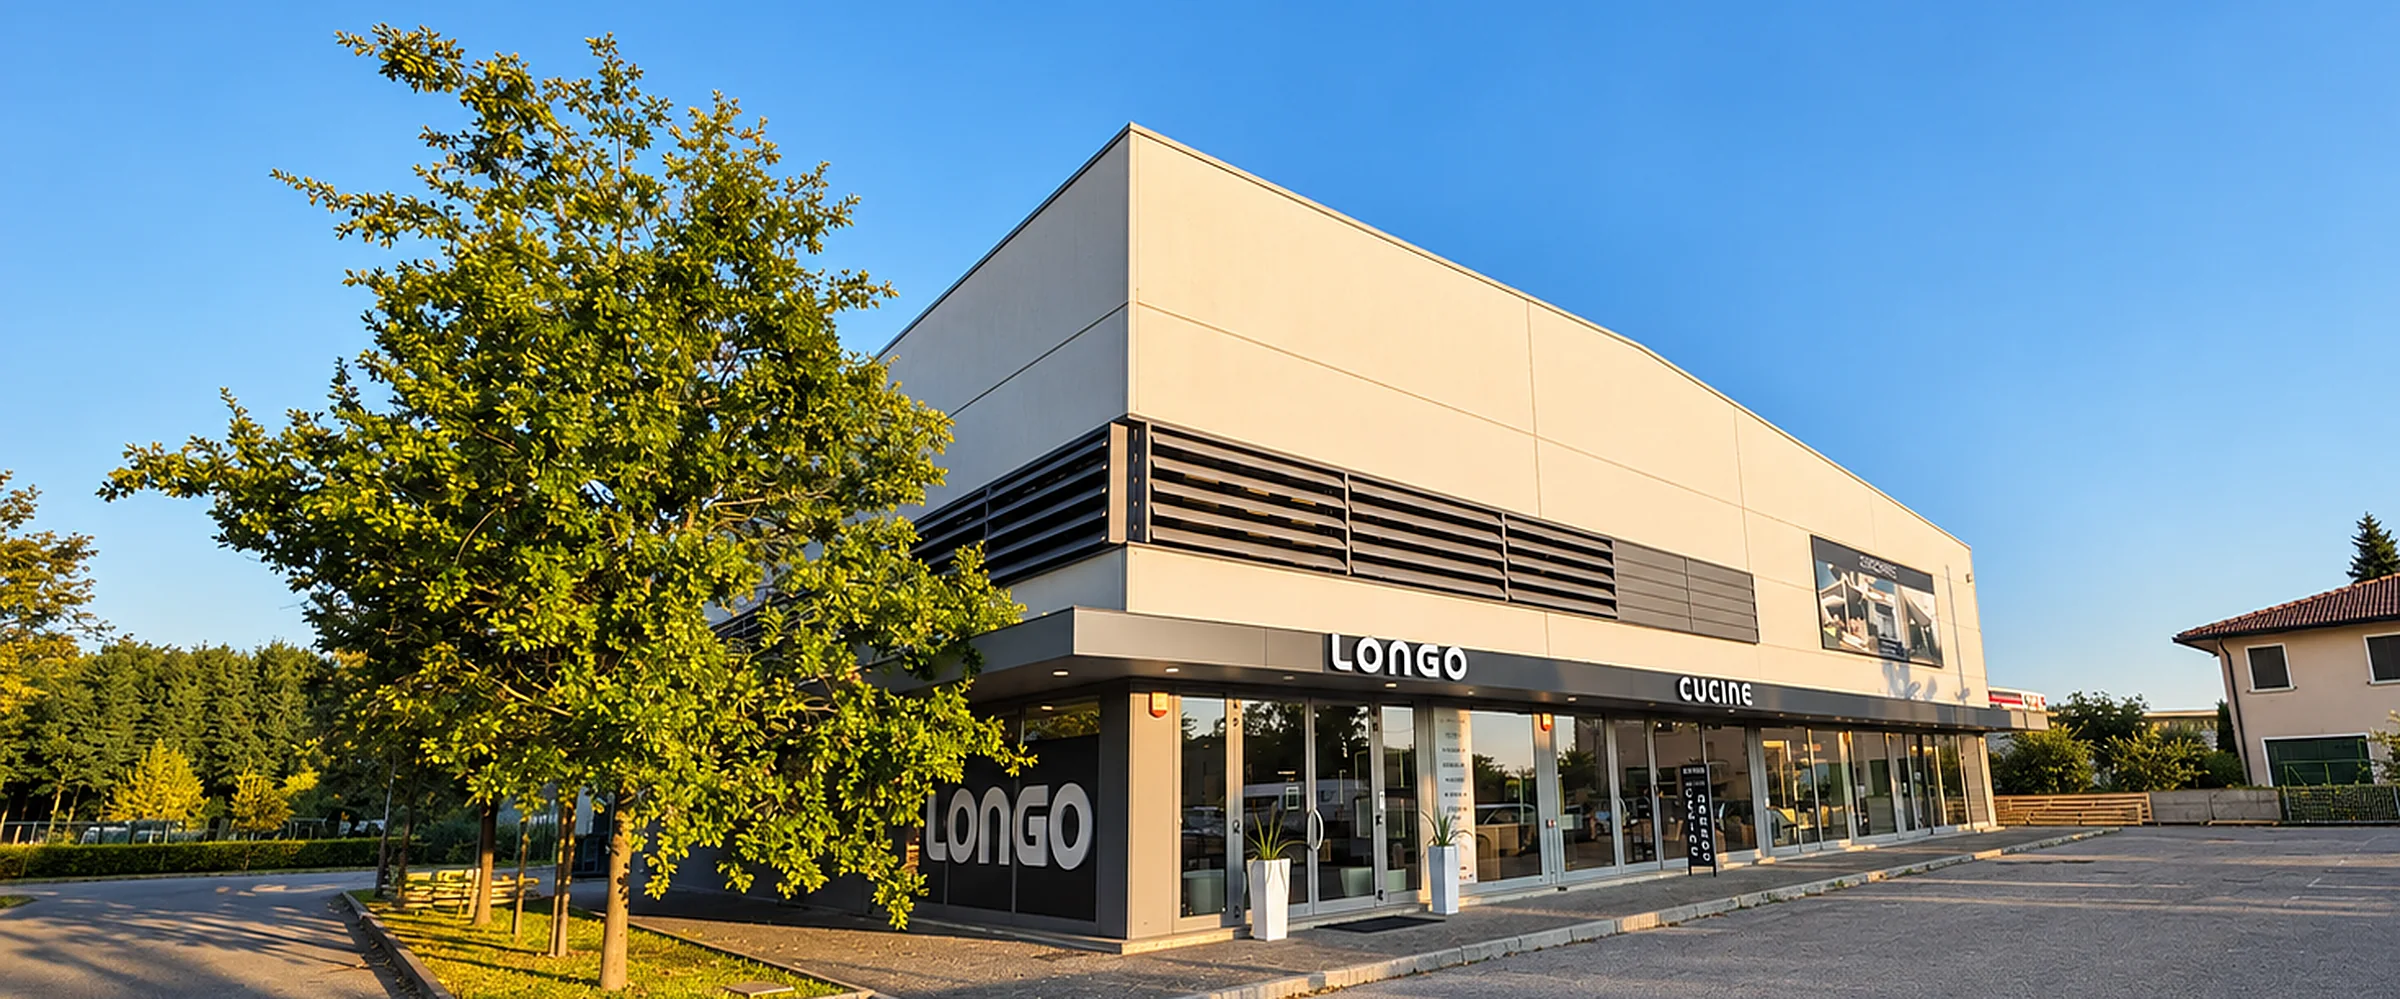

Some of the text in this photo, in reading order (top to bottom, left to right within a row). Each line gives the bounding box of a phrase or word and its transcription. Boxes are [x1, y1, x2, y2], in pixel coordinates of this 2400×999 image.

[1331, 633, 1467, 681] LONGO
[1680, 676, 1753, 706] CUCINE
[926, 782, 1093, 870] LONGO
